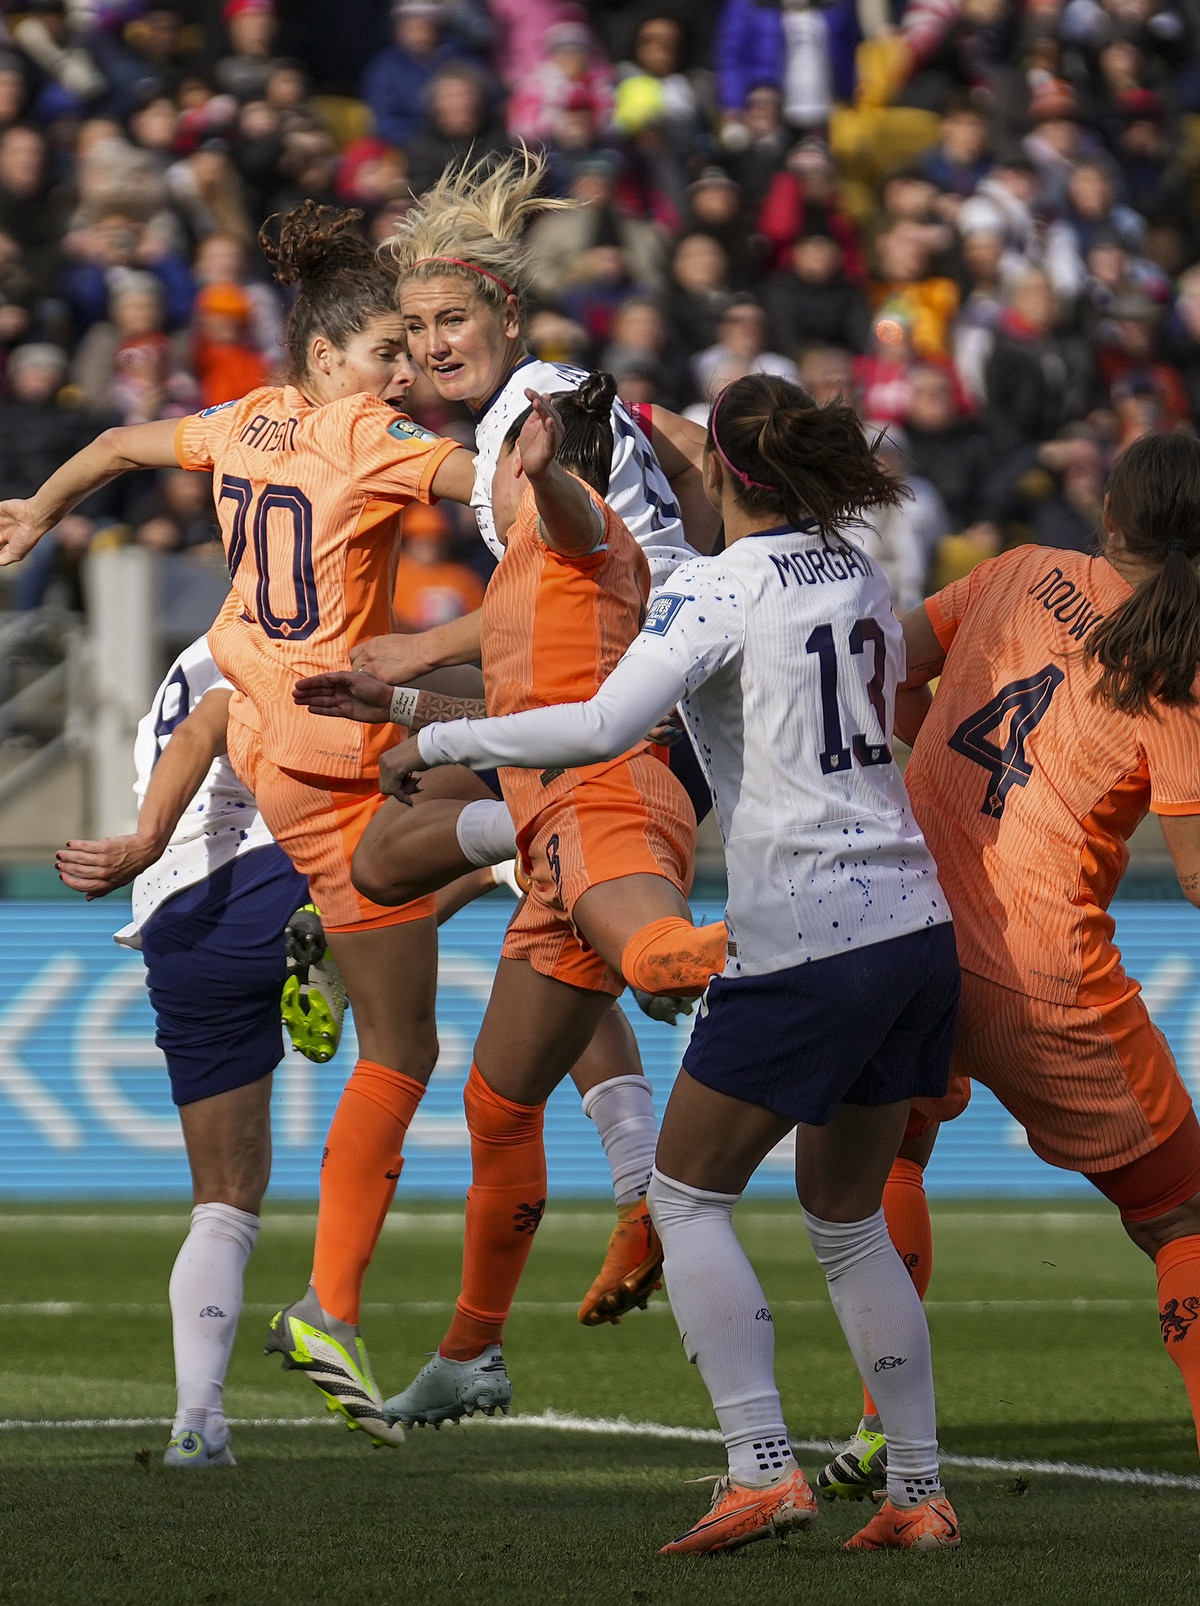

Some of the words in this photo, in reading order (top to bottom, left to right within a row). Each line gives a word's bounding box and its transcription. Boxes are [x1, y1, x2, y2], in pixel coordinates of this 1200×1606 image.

[1029, 566, 1105, 642] NOUW
[806, 617, 893, 774] 13
[947, 663, 1065, 819] 4
